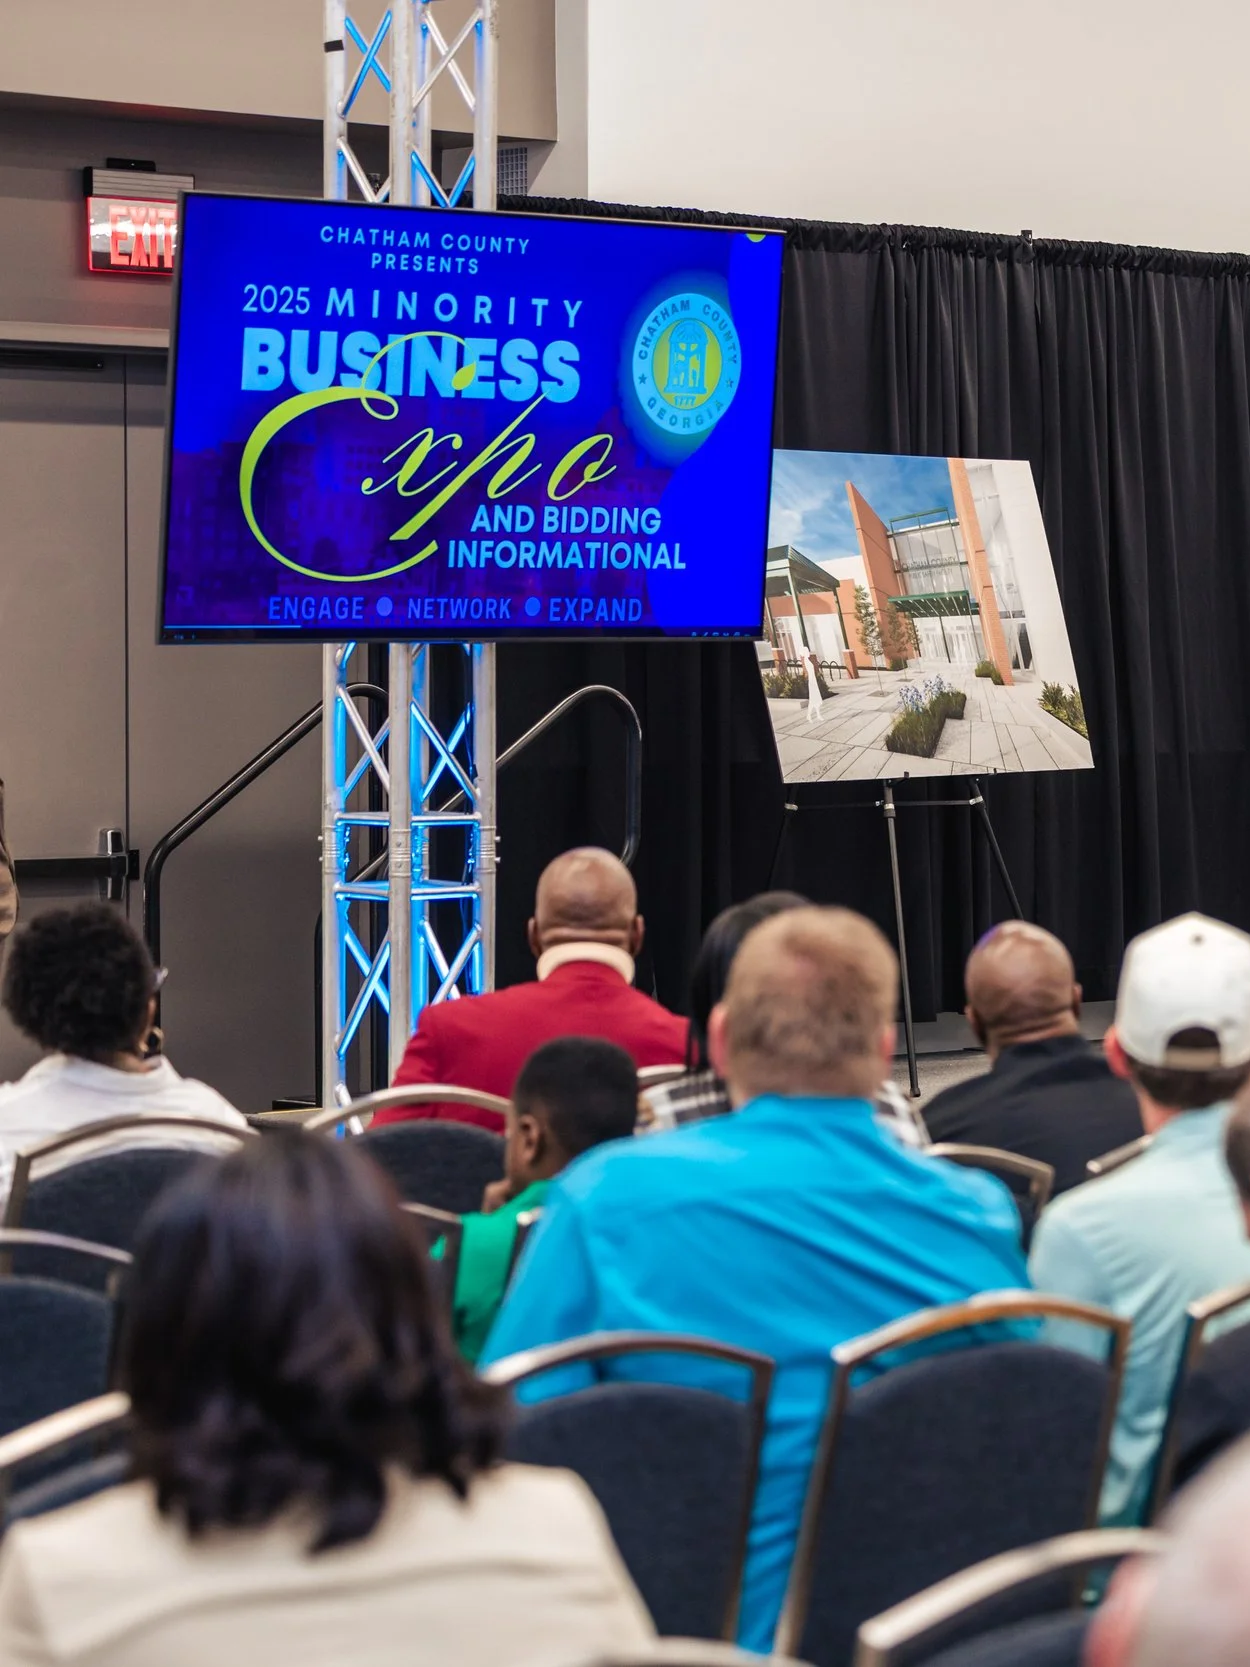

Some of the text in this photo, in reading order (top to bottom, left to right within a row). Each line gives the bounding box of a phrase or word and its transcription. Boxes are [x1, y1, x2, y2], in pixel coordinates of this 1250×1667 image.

[109, 205, 176, 268] EXIT
[319, 225, 531, 254] CHATHAM COUNTY
[371, 253, 479, 275] PRESENTS
[242, 284, 584, 328] 2025 MINORITY
[638, 300, 737, 364] CHATHAM COUNTY
[240, 327, 581, 403] BUSINESS
[647, 397, 724, 428] GEORGIA
[239, 331, 617, 582] Expo
[470, 504, 662, 535] AND BIDDING
[447, 540, 687, 570] INFORMATIONAL
[268, 597, 643, 622] ENGAGE NETWORK EXPAND
